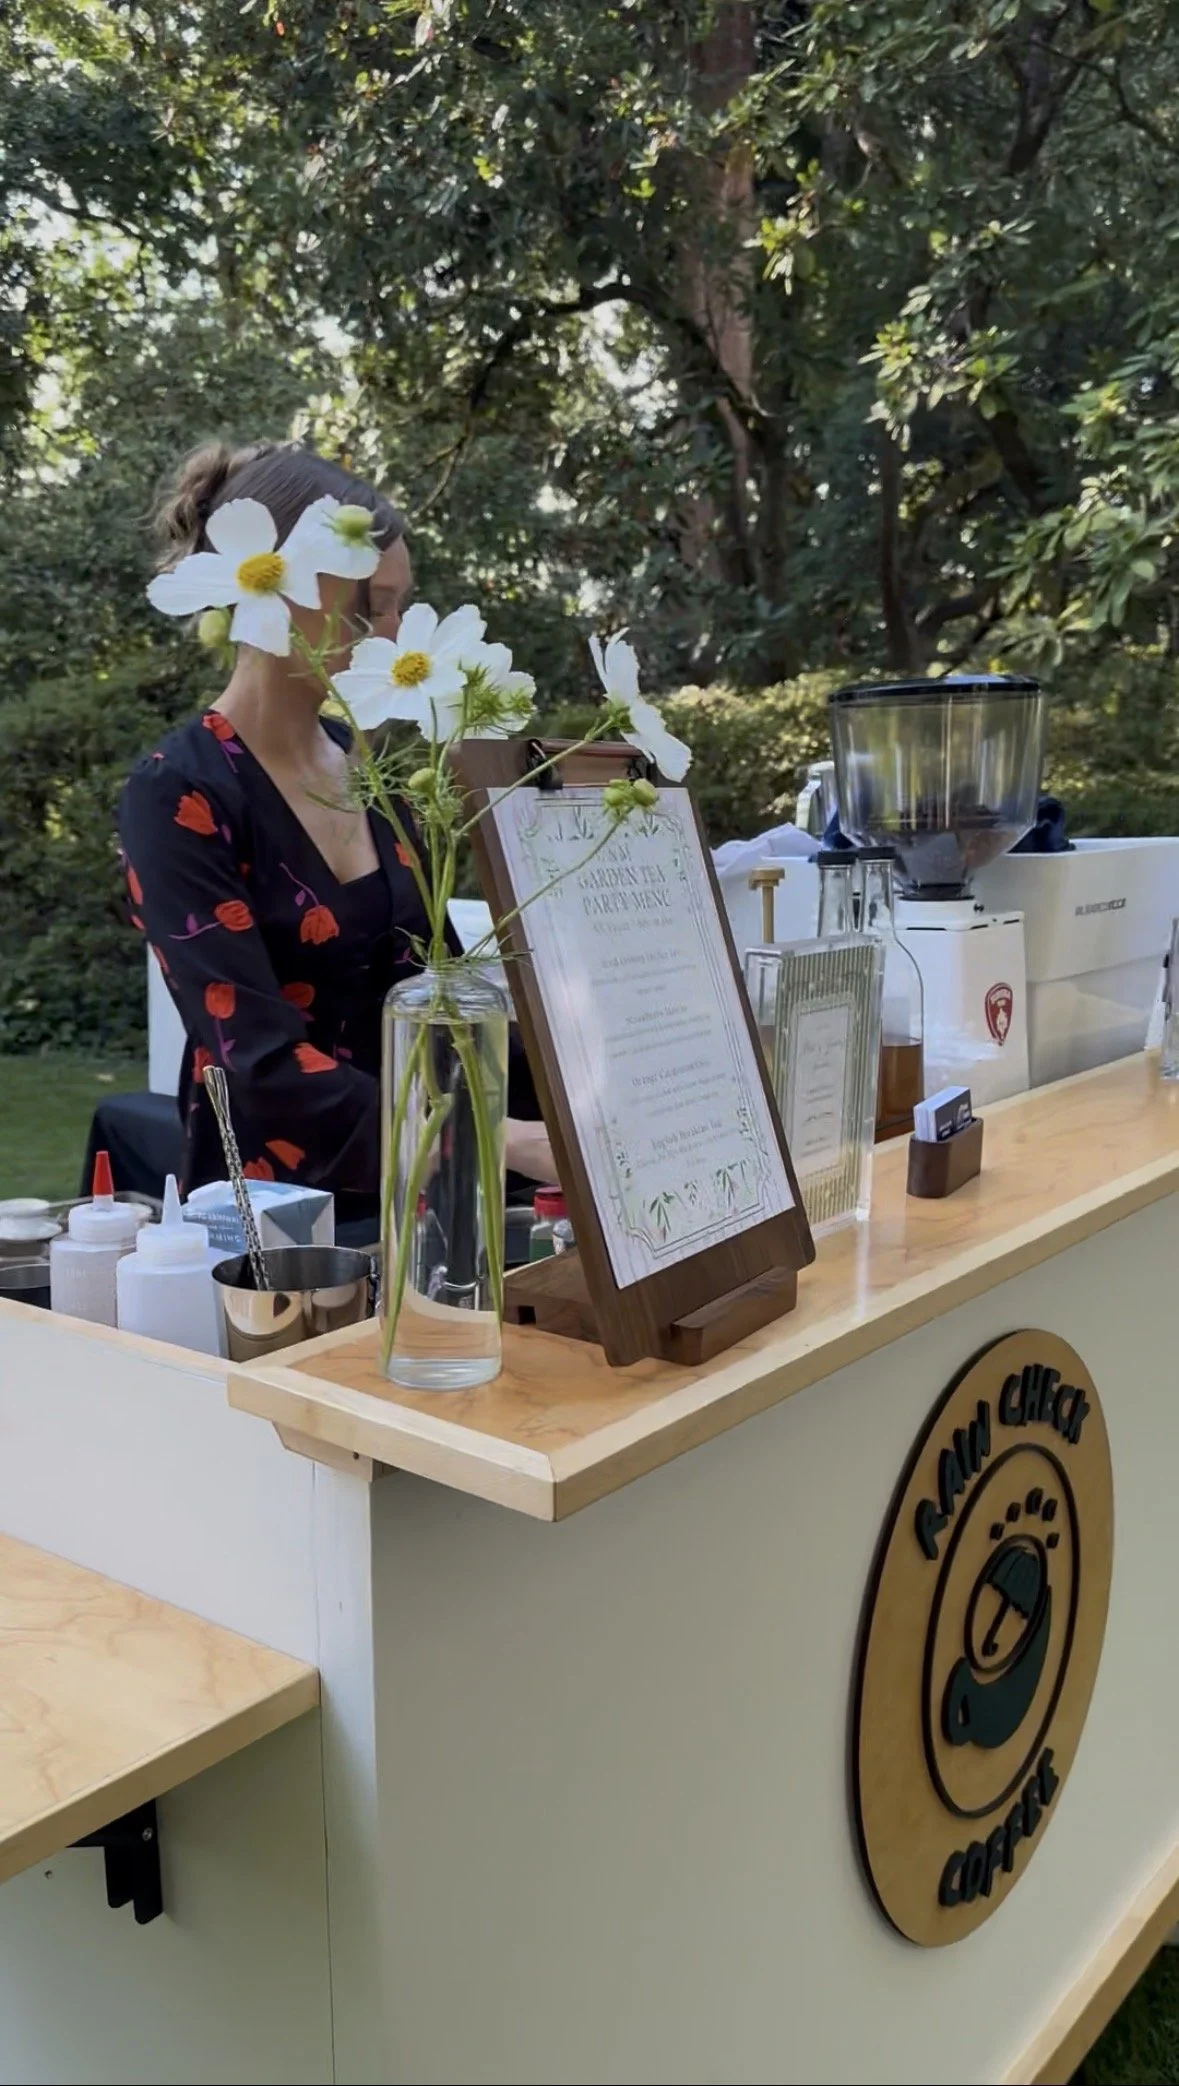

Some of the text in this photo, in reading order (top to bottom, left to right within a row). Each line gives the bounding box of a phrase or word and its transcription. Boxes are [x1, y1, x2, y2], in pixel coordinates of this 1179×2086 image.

[579, 864, 666, 889] GARDEN TEA
[582, 888, 671, 915] PARTY MENU
[914, 1363, 1091, 1560] RAIN CHECK
[938, 1747, 1059, 1908] COFFEE
